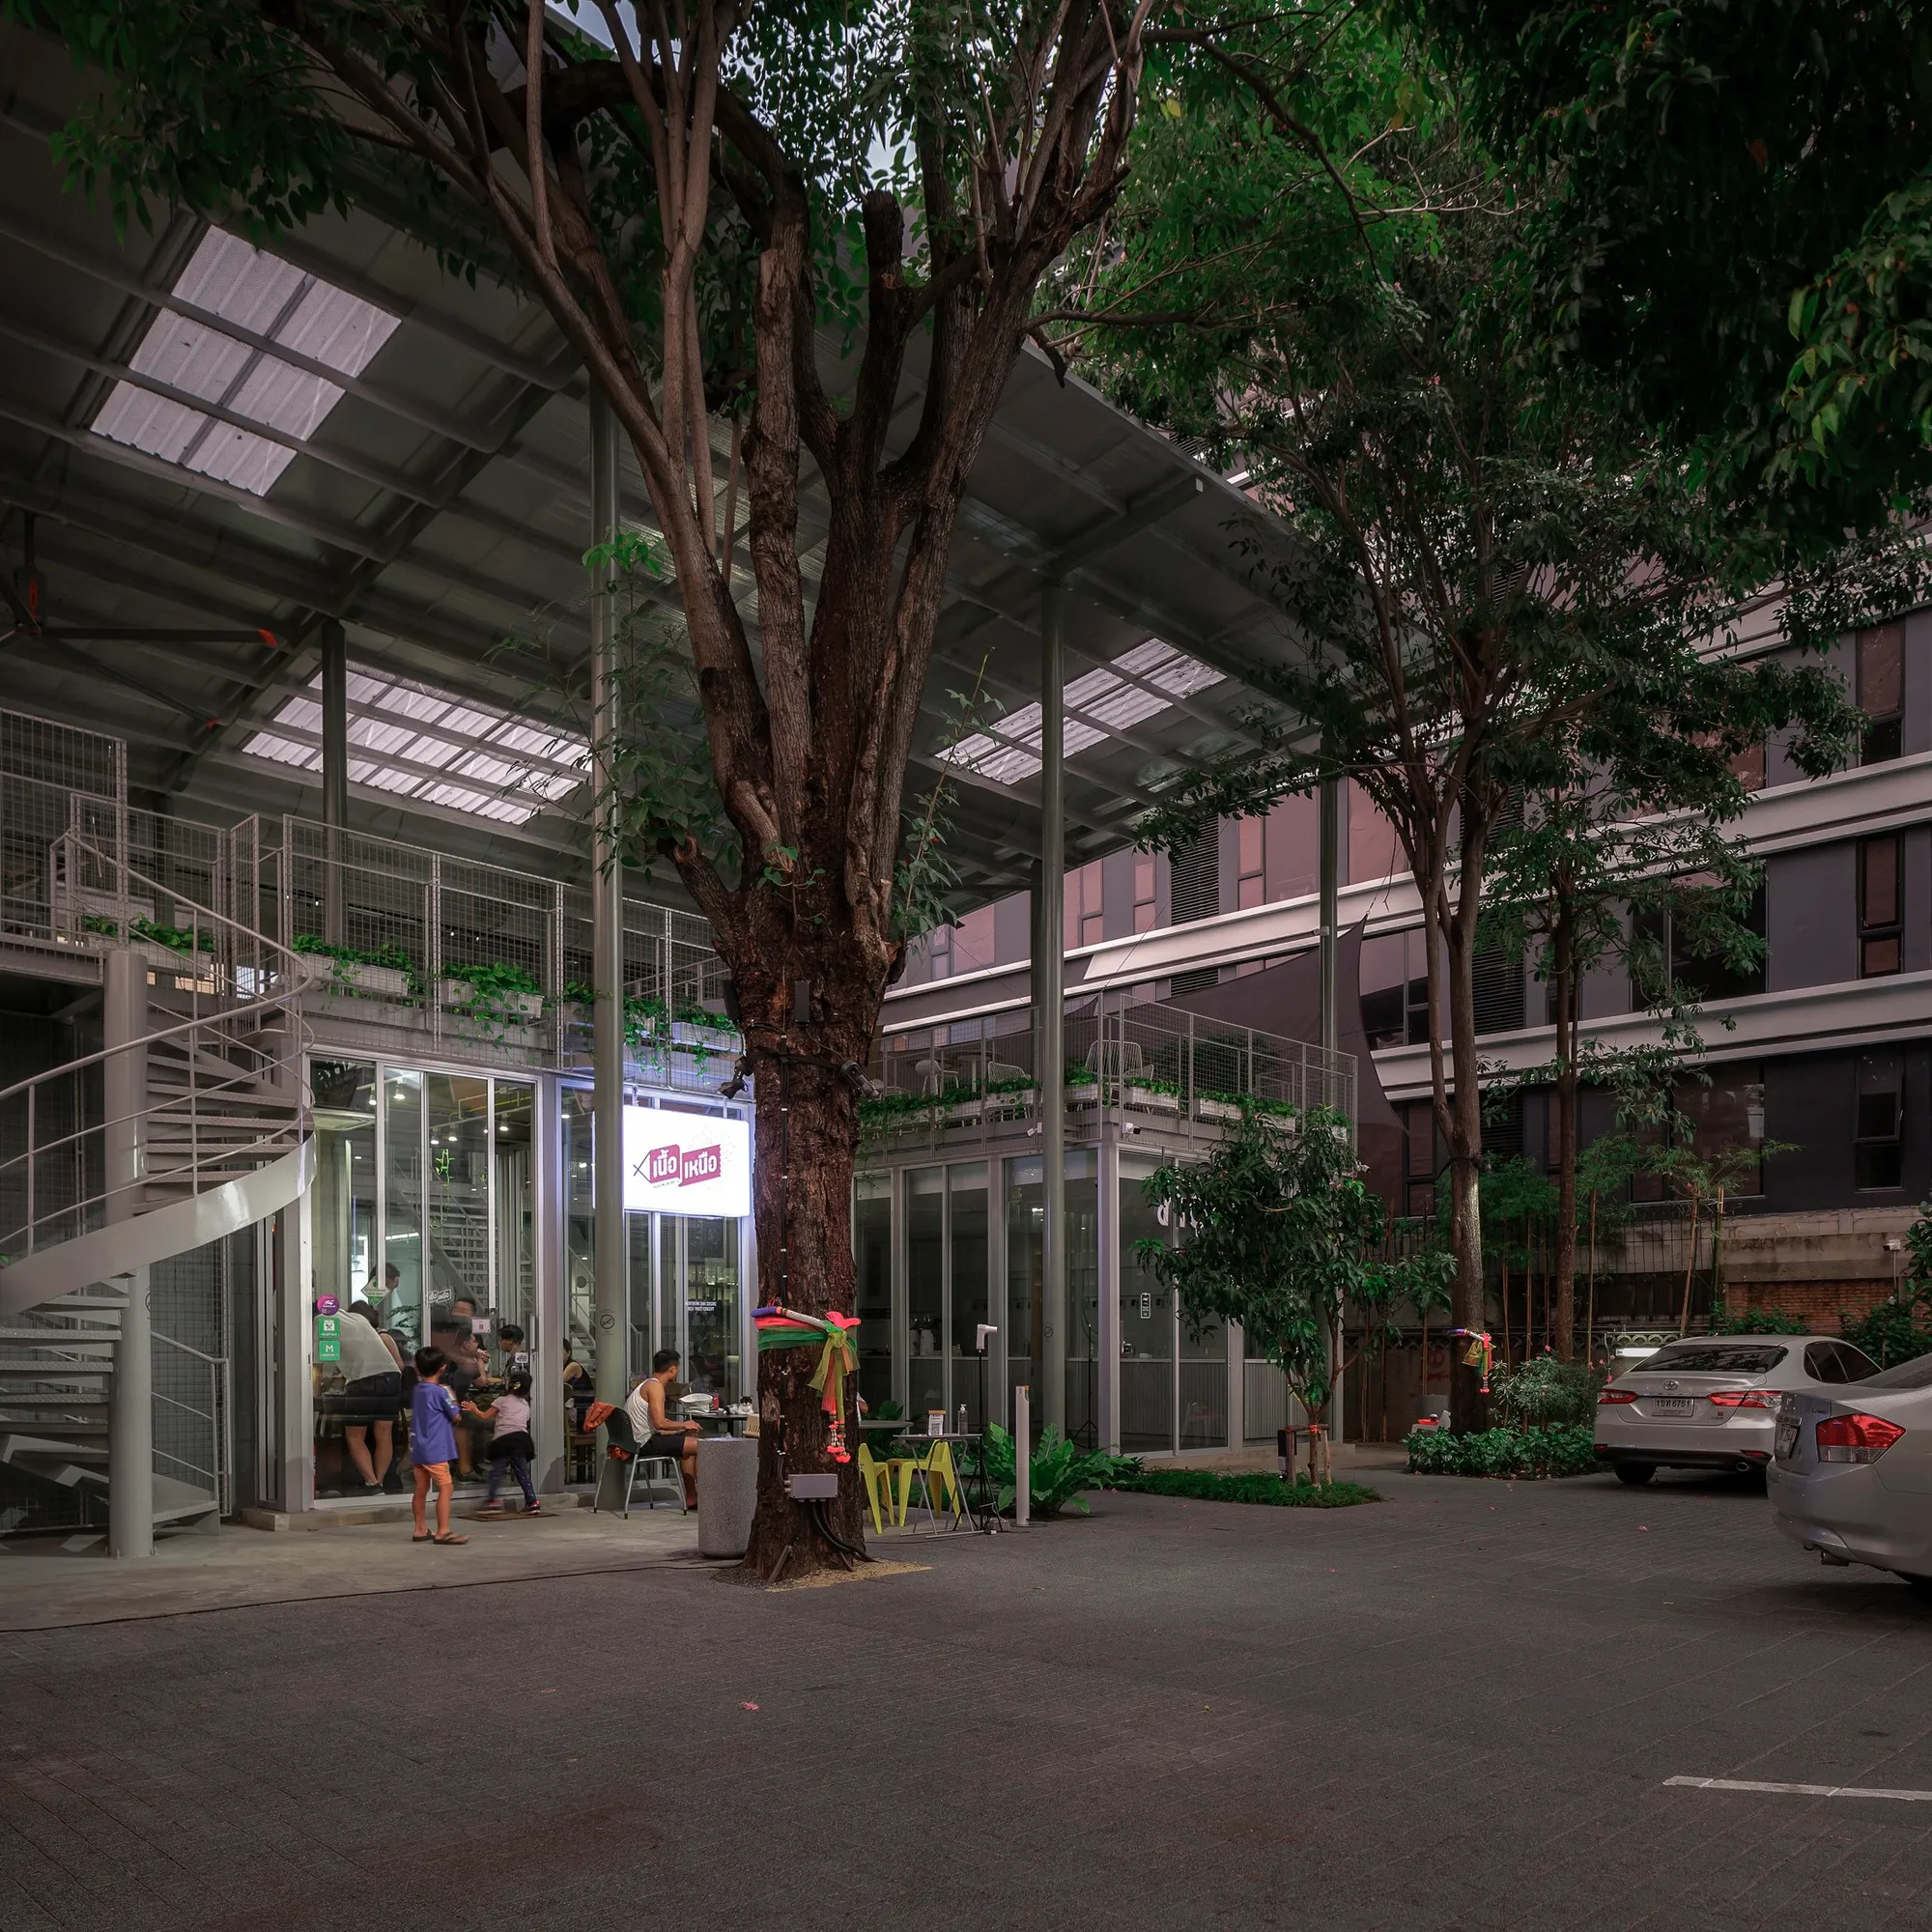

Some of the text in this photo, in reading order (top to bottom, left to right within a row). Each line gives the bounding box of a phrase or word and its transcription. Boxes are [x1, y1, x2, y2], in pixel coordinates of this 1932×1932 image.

[652, 1149, 717, 1179] เนื้อ เหนือ
[1672, 1400, 1690, 1408] 6751
